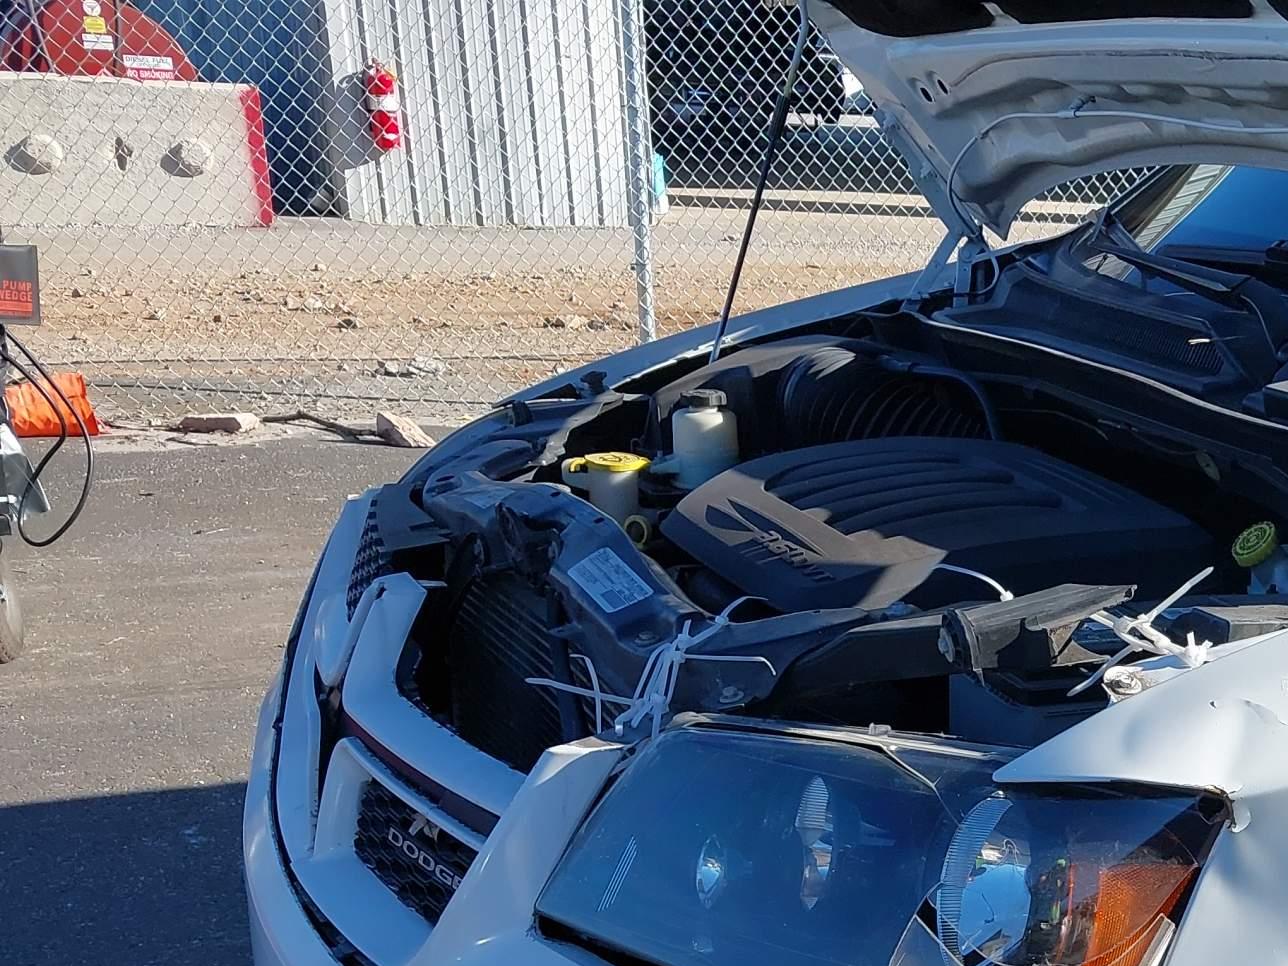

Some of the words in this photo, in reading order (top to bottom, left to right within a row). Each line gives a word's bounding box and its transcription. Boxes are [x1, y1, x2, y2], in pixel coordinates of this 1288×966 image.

[127, 69, 139, 77] NO
[139, 70, 175, 80] SMOKING
[3, 280, 32, 292] PUMP
